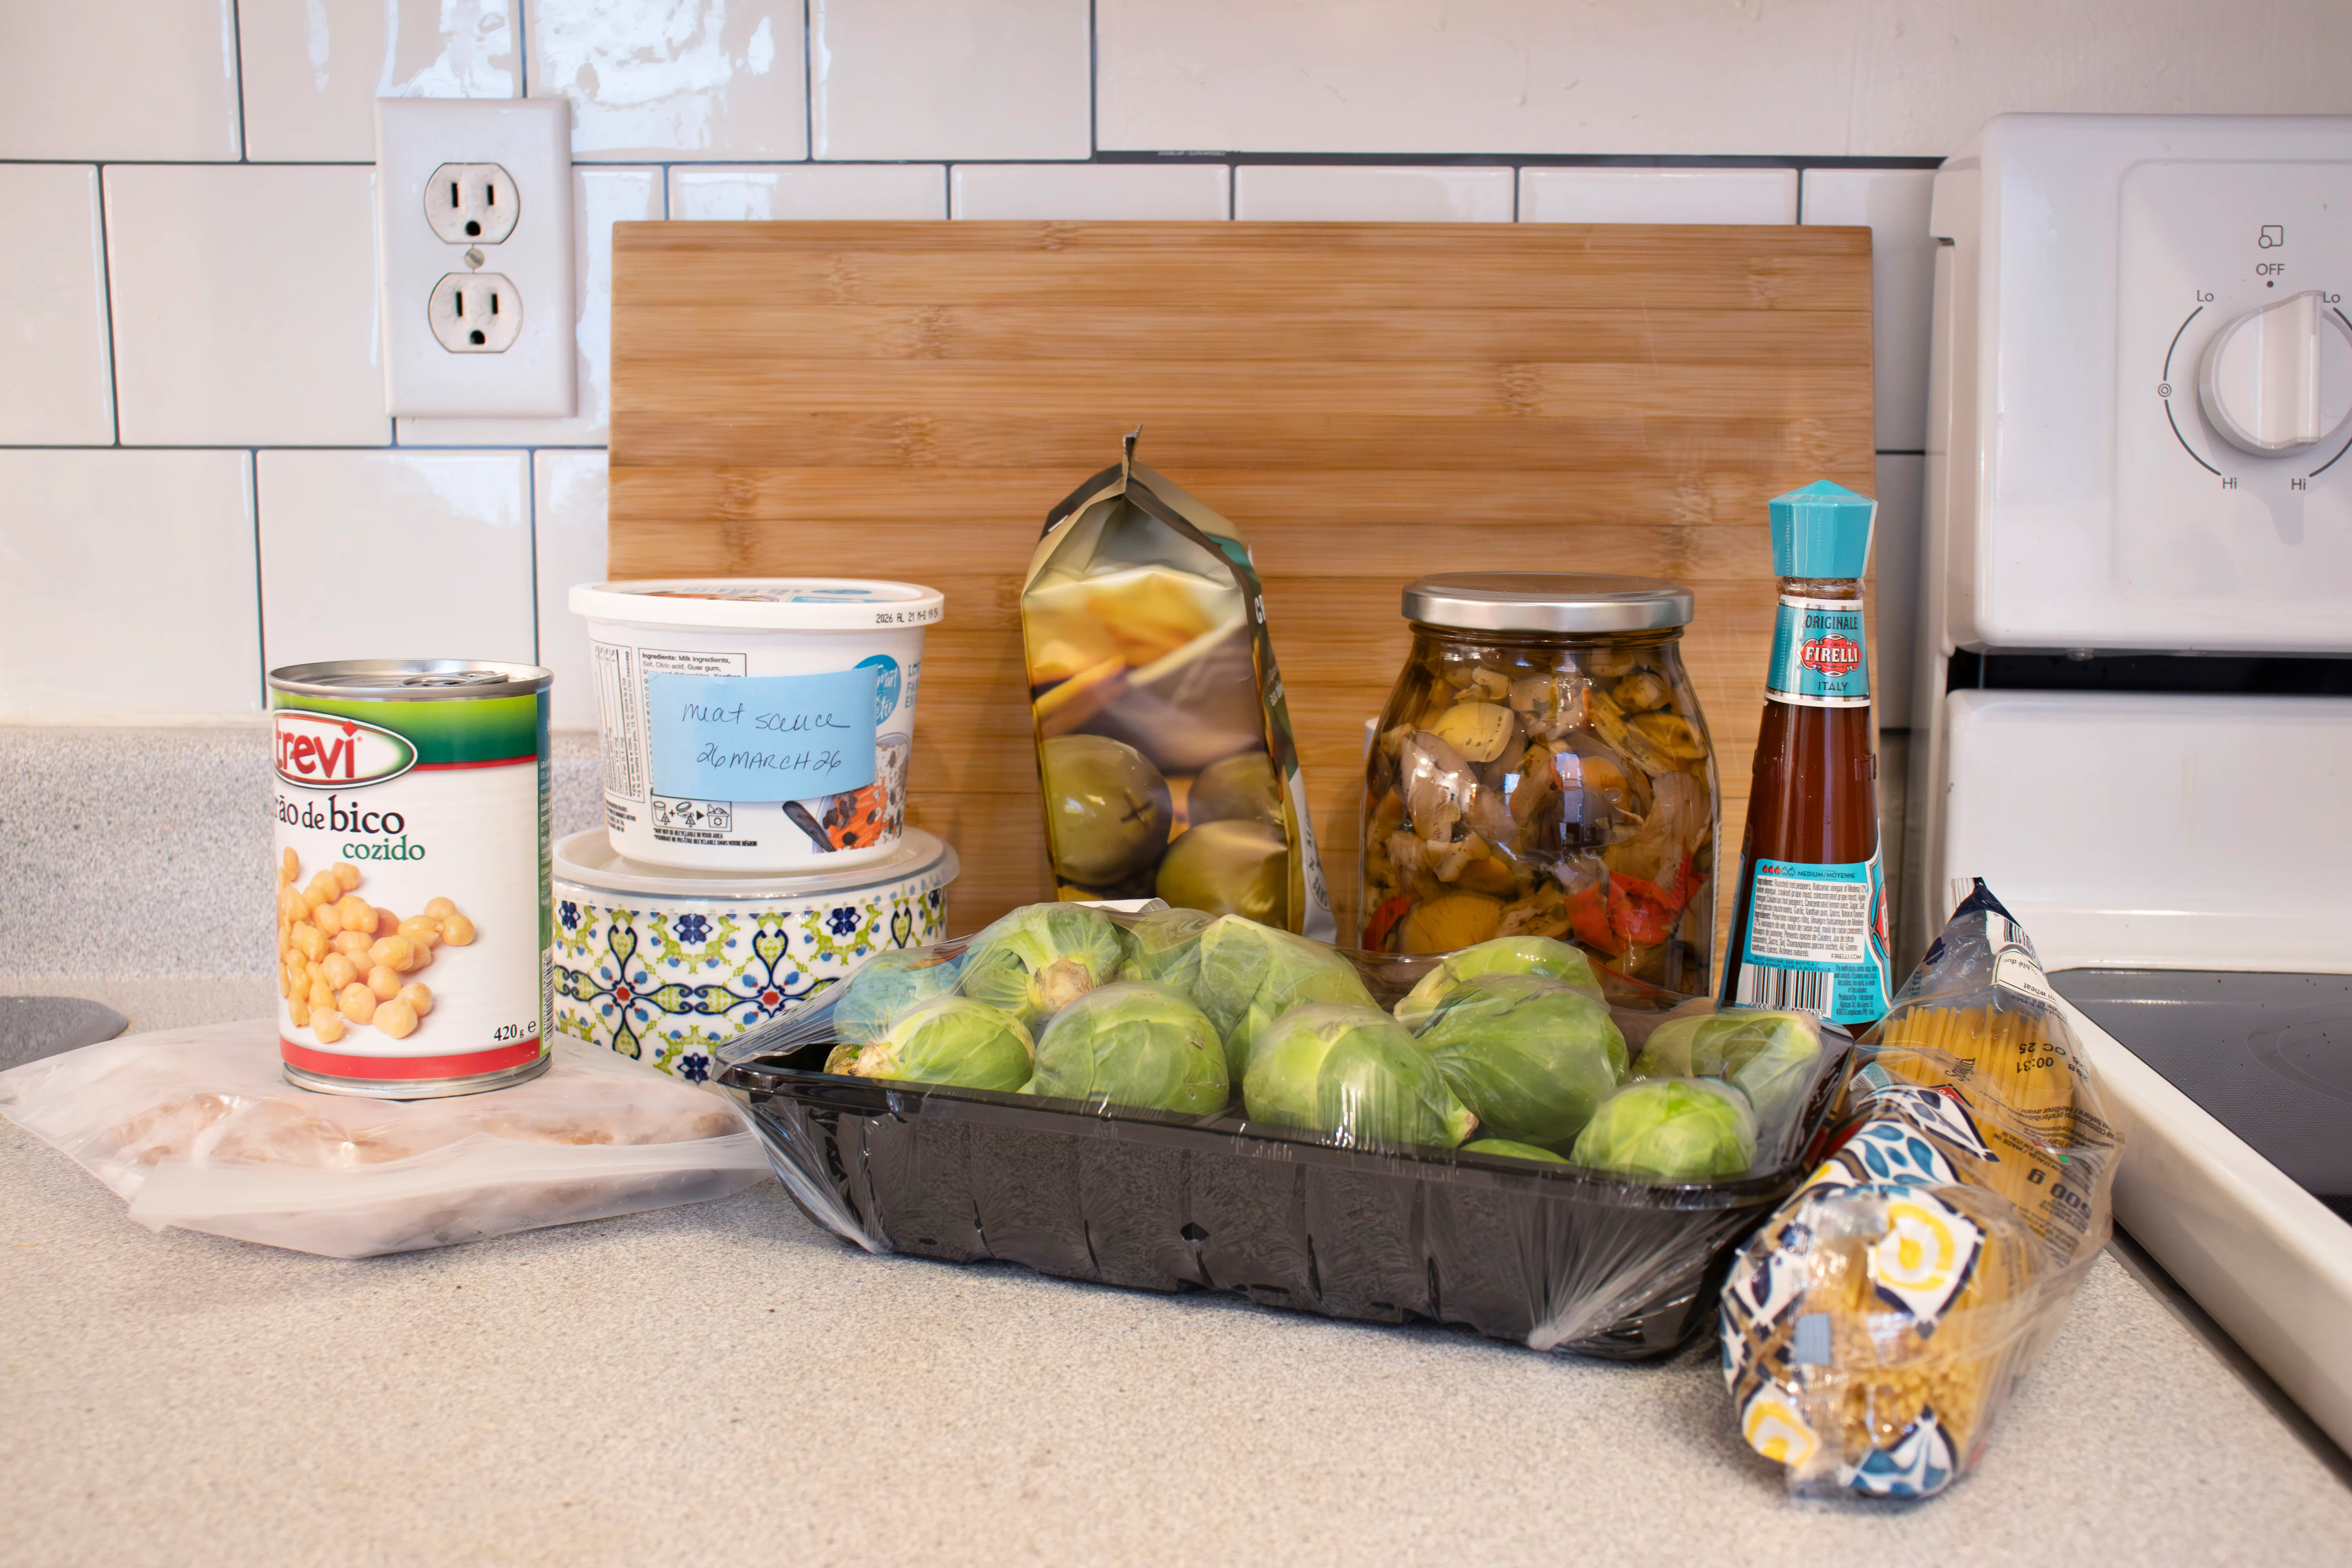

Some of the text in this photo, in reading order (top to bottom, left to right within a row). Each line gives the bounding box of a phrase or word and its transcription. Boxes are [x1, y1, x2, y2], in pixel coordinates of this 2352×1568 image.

[2256, 263, 2285, 276] OFF
[2197, 290, 2214, 302] Lo
[2323, 291, 2341, 303] Lo
[2223, 477, 2238, 490] Hi
[2291, 478, 2306, 491] Hi
[876, 613, 893, 623] 2026
[1805, 615, 1858, 630] ORIGINALE
[642, 652, 677, 661] Ingredients:
[1805, 646, 1858, 662] FIRELLI
[1818, 681, 1848, 691] ITALY
[276, 720, 355, 778] trevi
[730, 751, 811, 770] MARCH
[813, 750, 841, 777] 26
[275, 794, 405, 835] rão de bico
[343, 834, 425, 860] cozido
[2018, 961, 2030, 970] blé
[2024, 982, 2046, 996] wheat
[494, 1024, 517, 1041] 420
[520, 1029, 524, 1038] g
[2019, 1042, 2066, 1056] OC 25
[2017, 1057, 2054, 1074] 00:31
[2043, 1105, 2073, 1114] Meilleur
[2027, 1168, 2046, 1185] g
